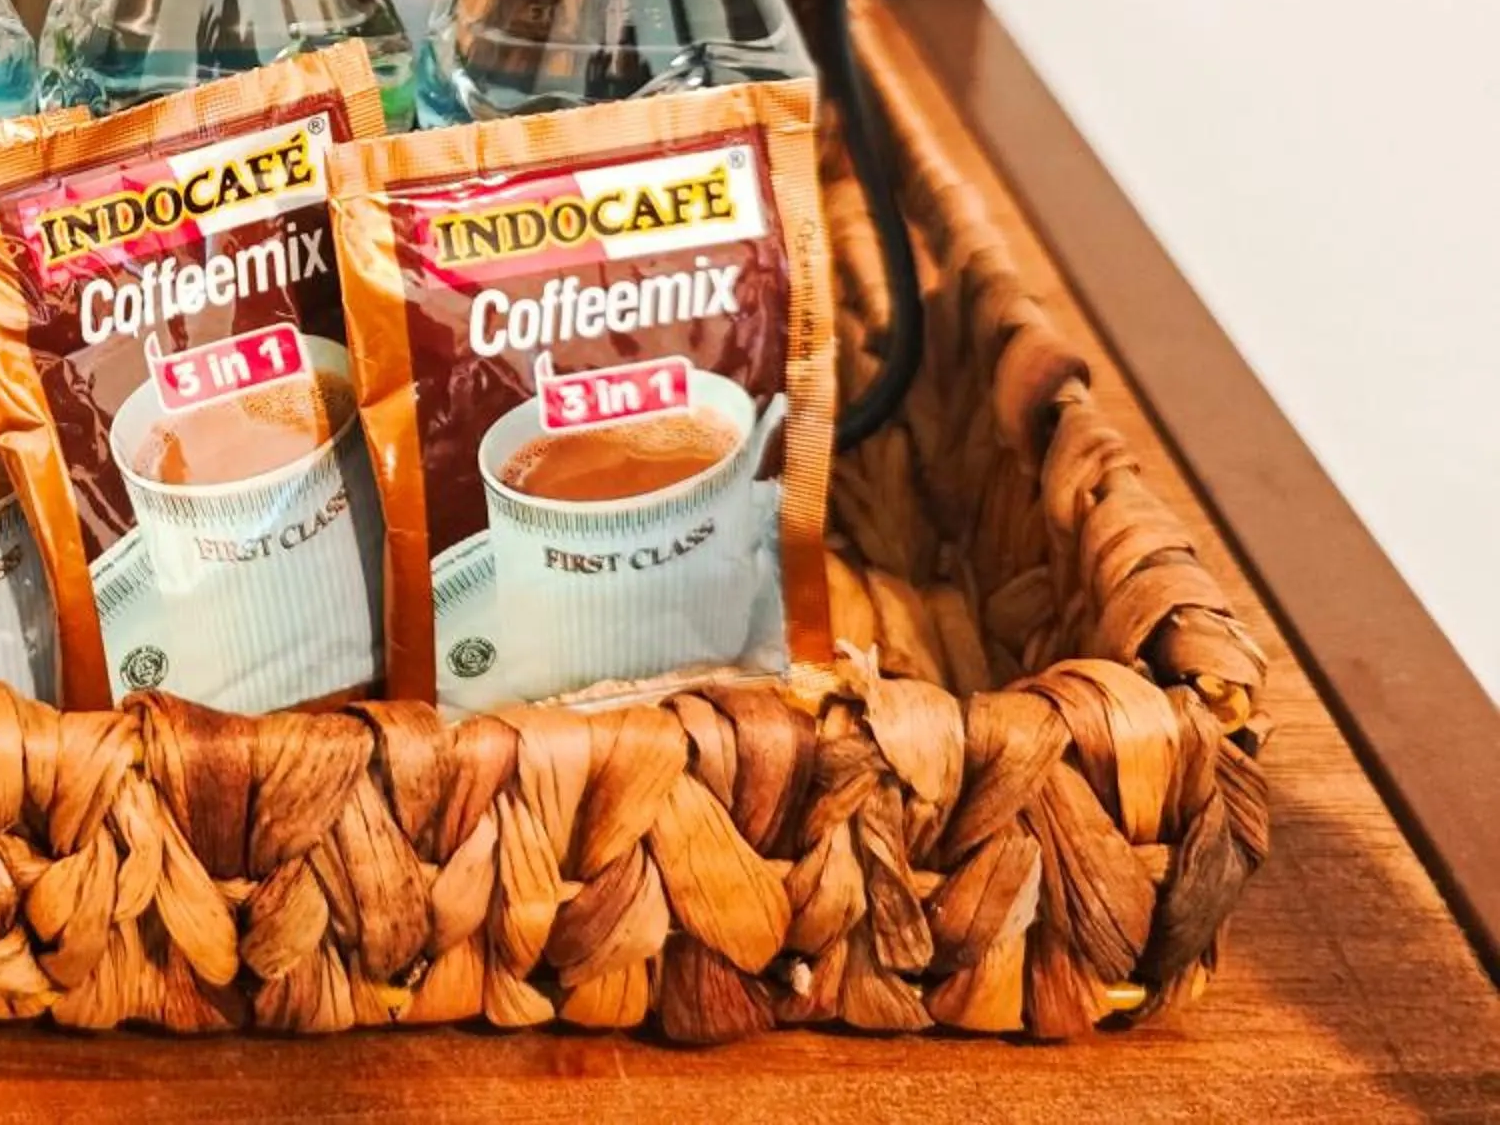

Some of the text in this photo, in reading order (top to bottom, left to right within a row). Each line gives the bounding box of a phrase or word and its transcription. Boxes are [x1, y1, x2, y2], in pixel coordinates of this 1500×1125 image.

[41, 134, 312, 259] INDOCAFÉ
[436, 167, 732, 262] INDOCAFÉ
[80, 222, 328, 344] Coffeemix
[468, 256, 740, 357] Coffeemix
[171, 361, 201, 398] 3
[257, 335, 286, 373] 1
[557, 384, 587, 420] 3
[648, 369, 675, 402] 1
[194, 535, 272, 562] FIRST
[544, 518, 715, 574] FIRST CLASS
